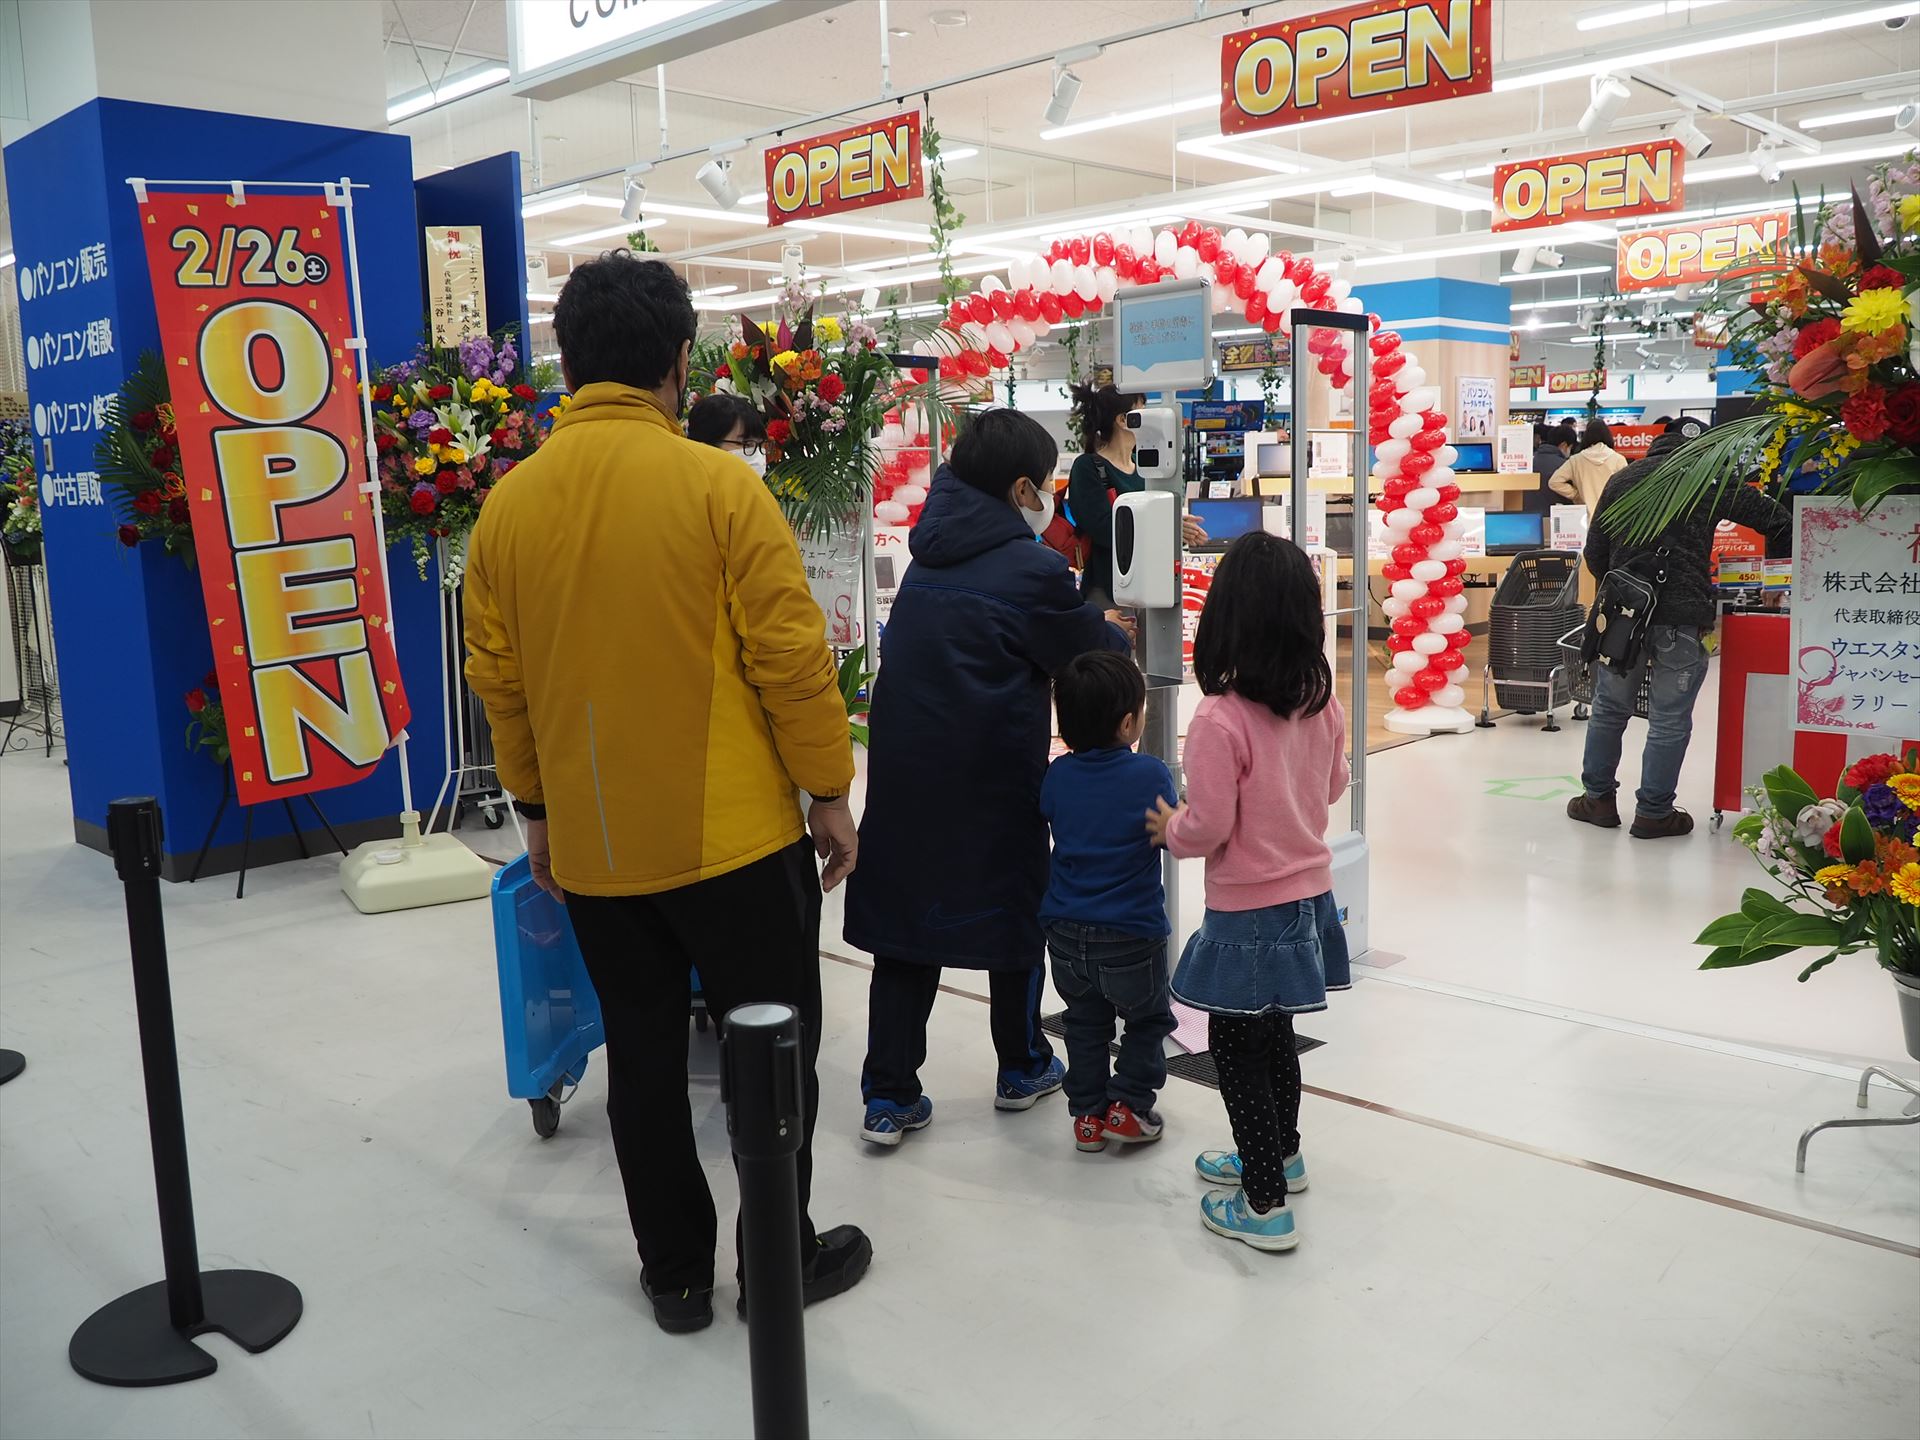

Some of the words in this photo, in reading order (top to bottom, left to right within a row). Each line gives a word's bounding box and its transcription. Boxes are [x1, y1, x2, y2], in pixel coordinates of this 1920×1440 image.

[1235, 0, 1473, 116] OPEN
[772, 124, 911, 213] OPEN
[1502, 148, 1672, 221] OPEN
[33, 242, 107, 299] パソコン販売
[1626, 219, 1778, 281] OPEN
[40, 317, 114, 368] パソコン相談
[53, 471, 104, 506] 中古買取
[199, 298, 391, 786] OPEN
[1823, 571, 1920, 594] 株式会社
[1834, 607, 1920, 626] 代表取締役
